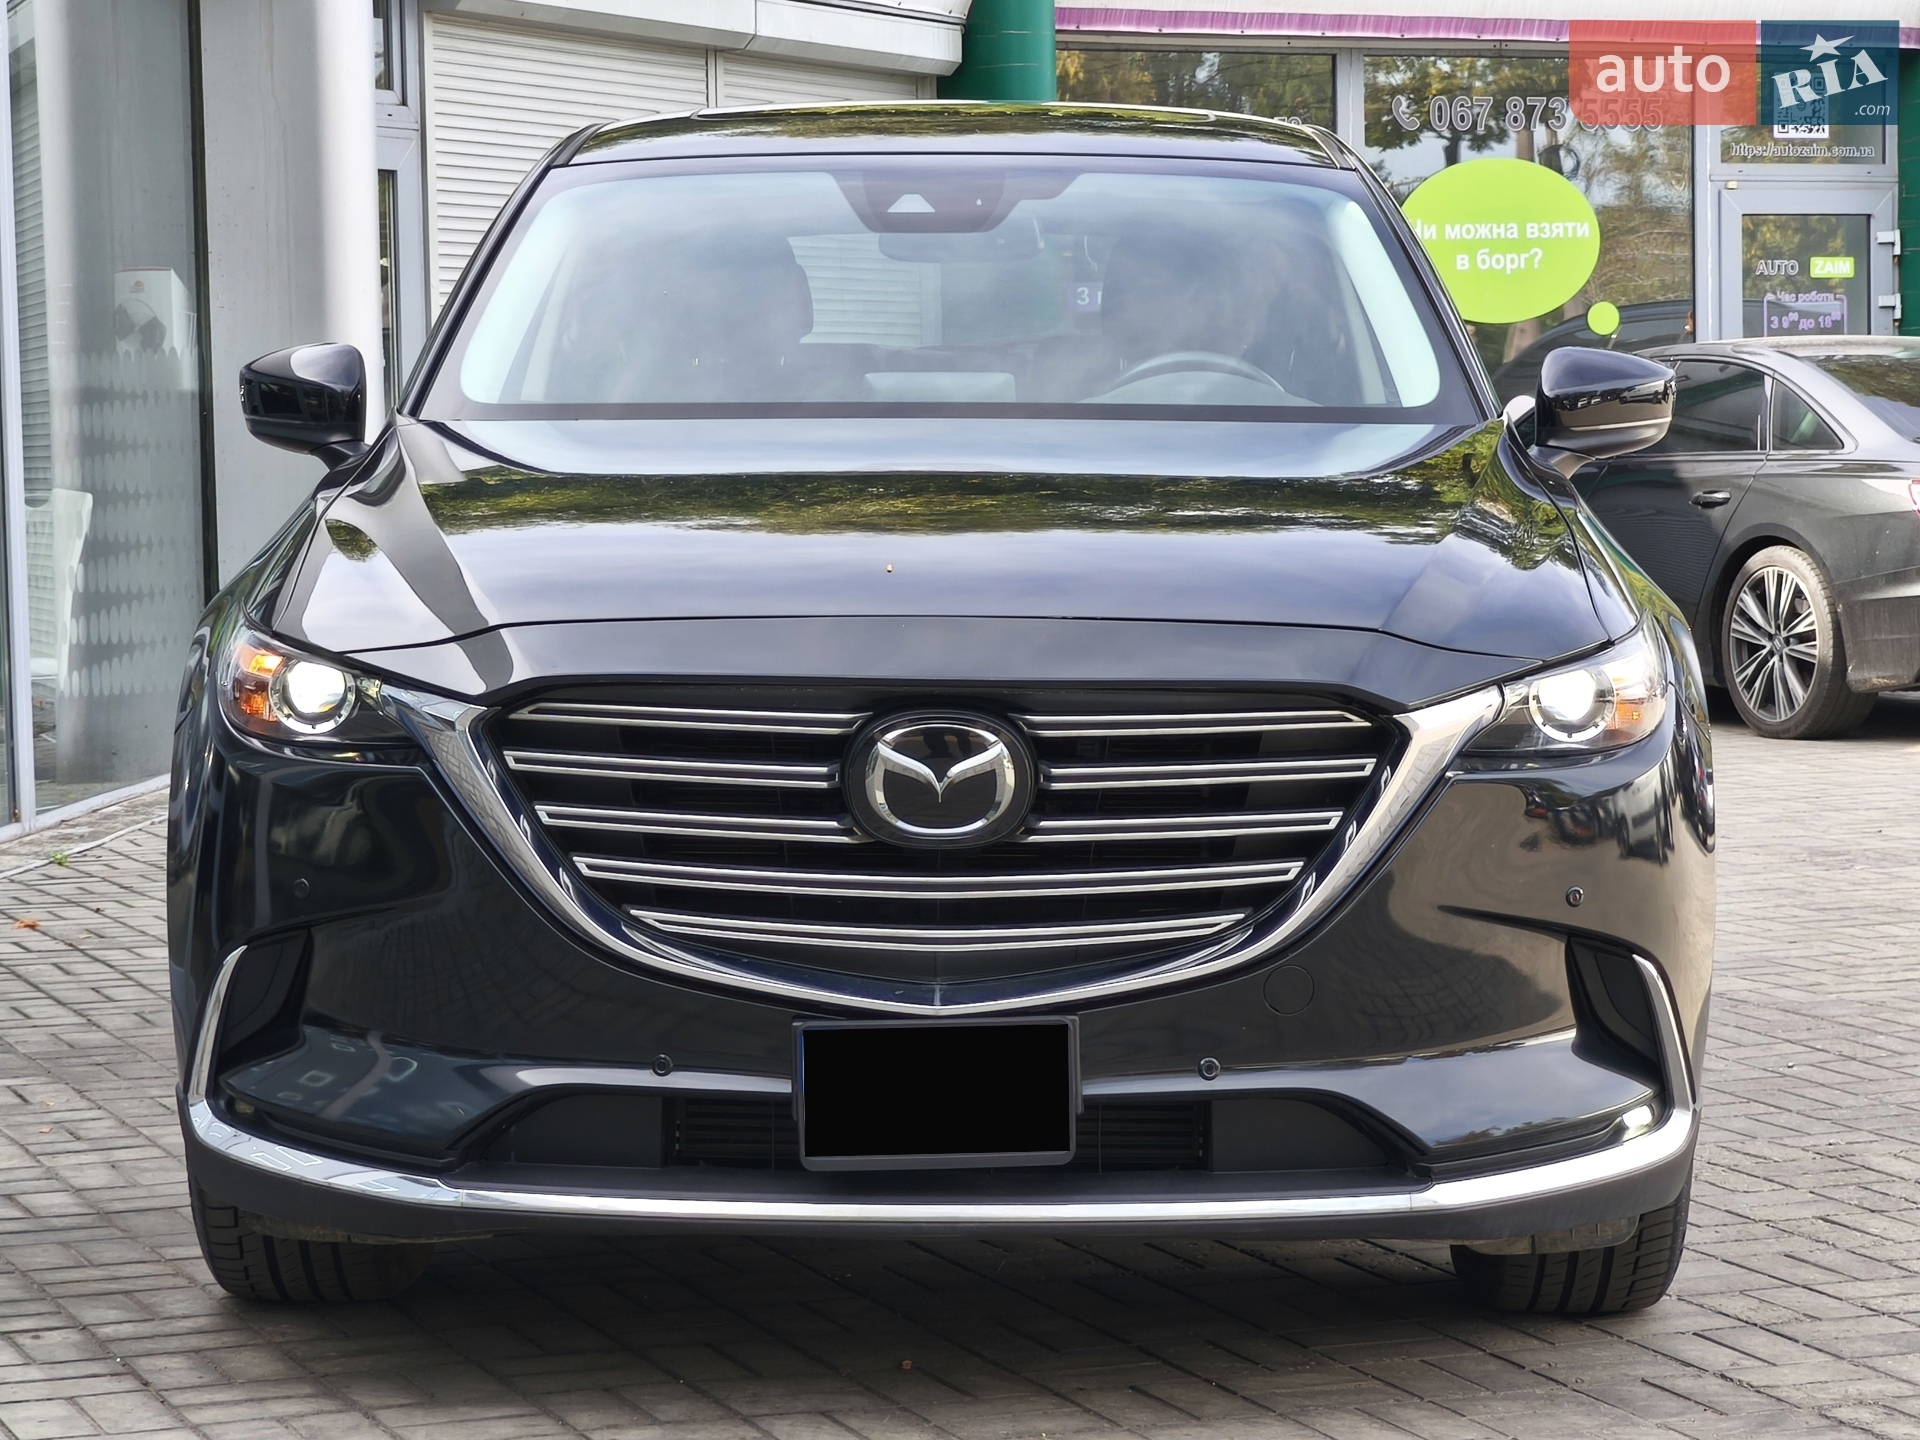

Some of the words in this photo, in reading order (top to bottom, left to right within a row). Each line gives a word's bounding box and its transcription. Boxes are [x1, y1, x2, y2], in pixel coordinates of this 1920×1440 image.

[1430, 96, 1493, 131] 067
[1505, 97, 1567, 131] 873
[1580, 98, 1662, 131] 5555
[1730, 142, 1875, 158] https://autozaim.com.ua
[1445, 223, 1518, 240] можна
[1526, 221, 1590, 238] взяти
[1456, 254, 1469, 270] в
[1476, 247, 1542, 274] борг?
[1755, 259, 1799, 275] AUTO
[1814, 260, 1850, 274] ZAIM
